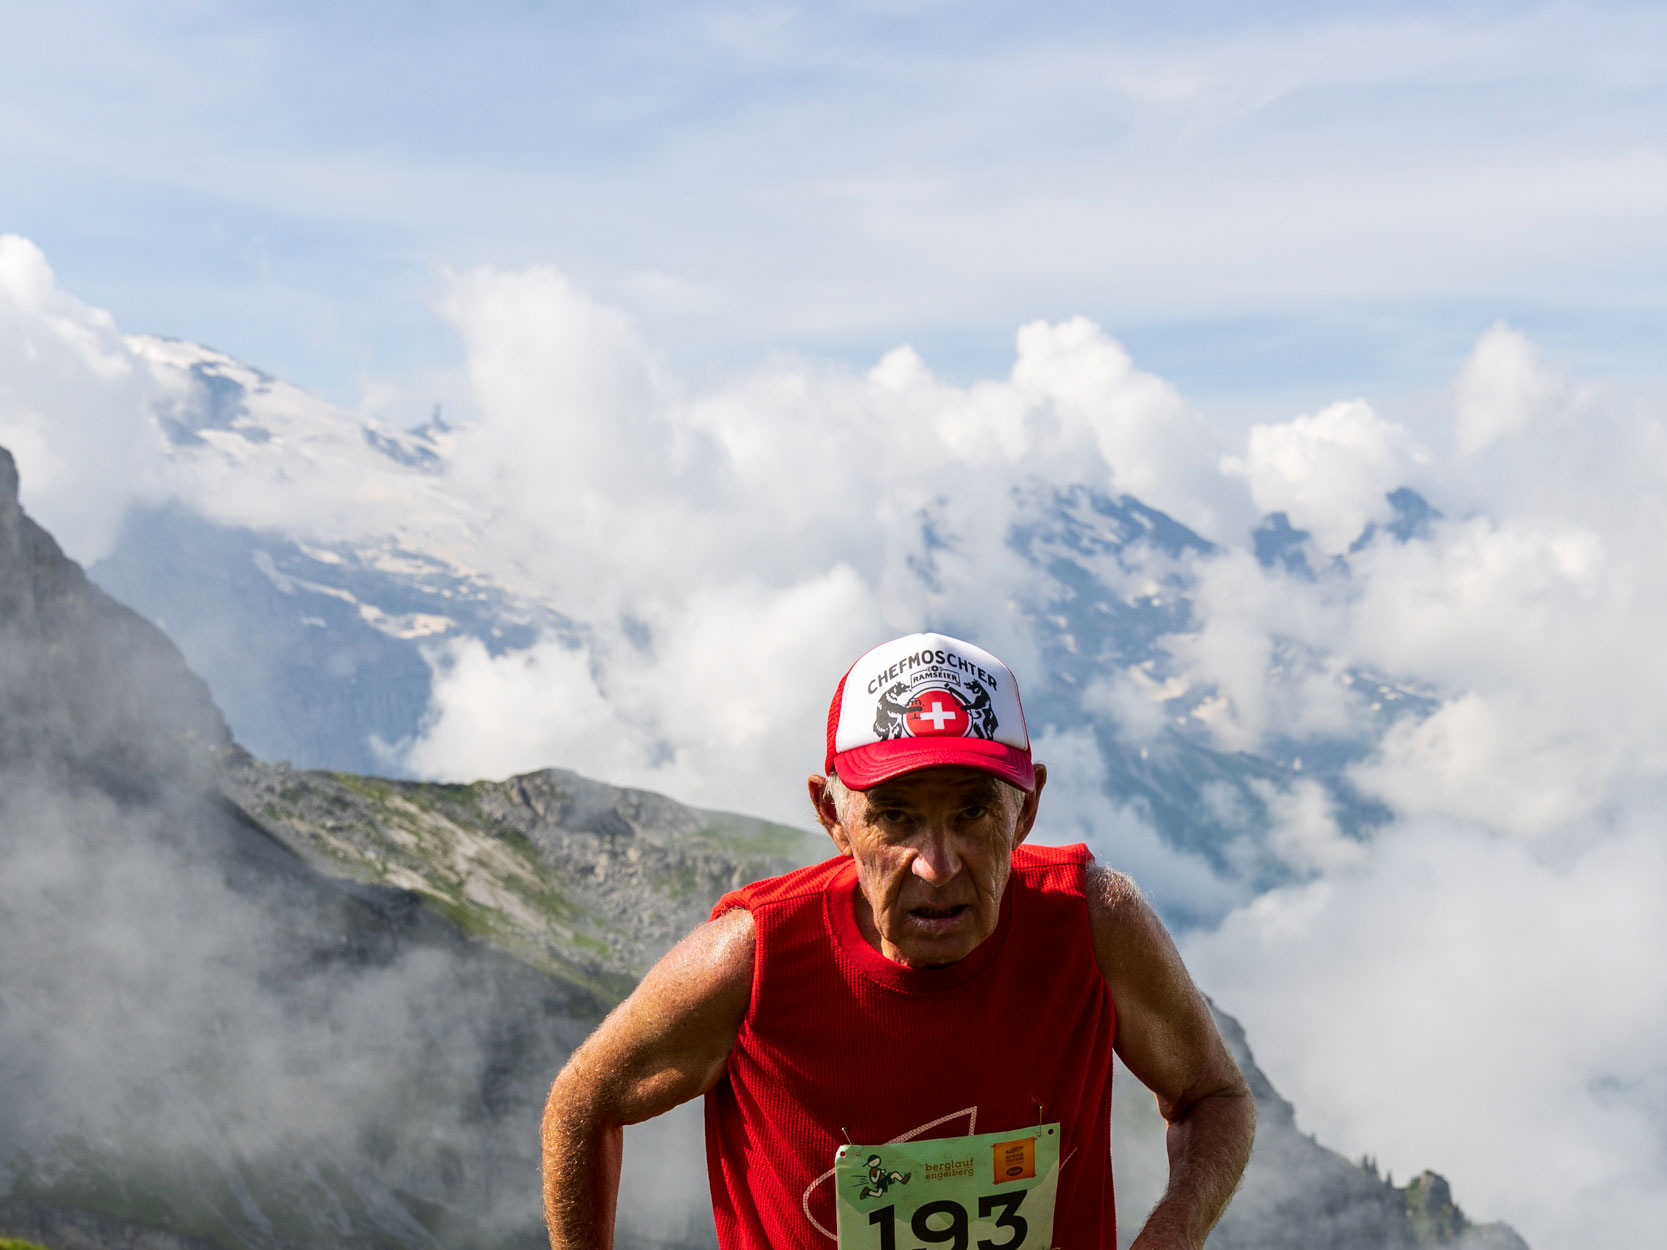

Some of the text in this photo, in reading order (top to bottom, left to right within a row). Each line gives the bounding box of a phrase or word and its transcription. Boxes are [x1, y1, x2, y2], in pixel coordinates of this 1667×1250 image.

[868, 650, 998, 694] CHEFMOSCHTER
[913, 672, 958, 683] RAMSEIER
[925, 1157, 975, 1171] berglauf
[925, 1168, 975, 1180] engelberg
